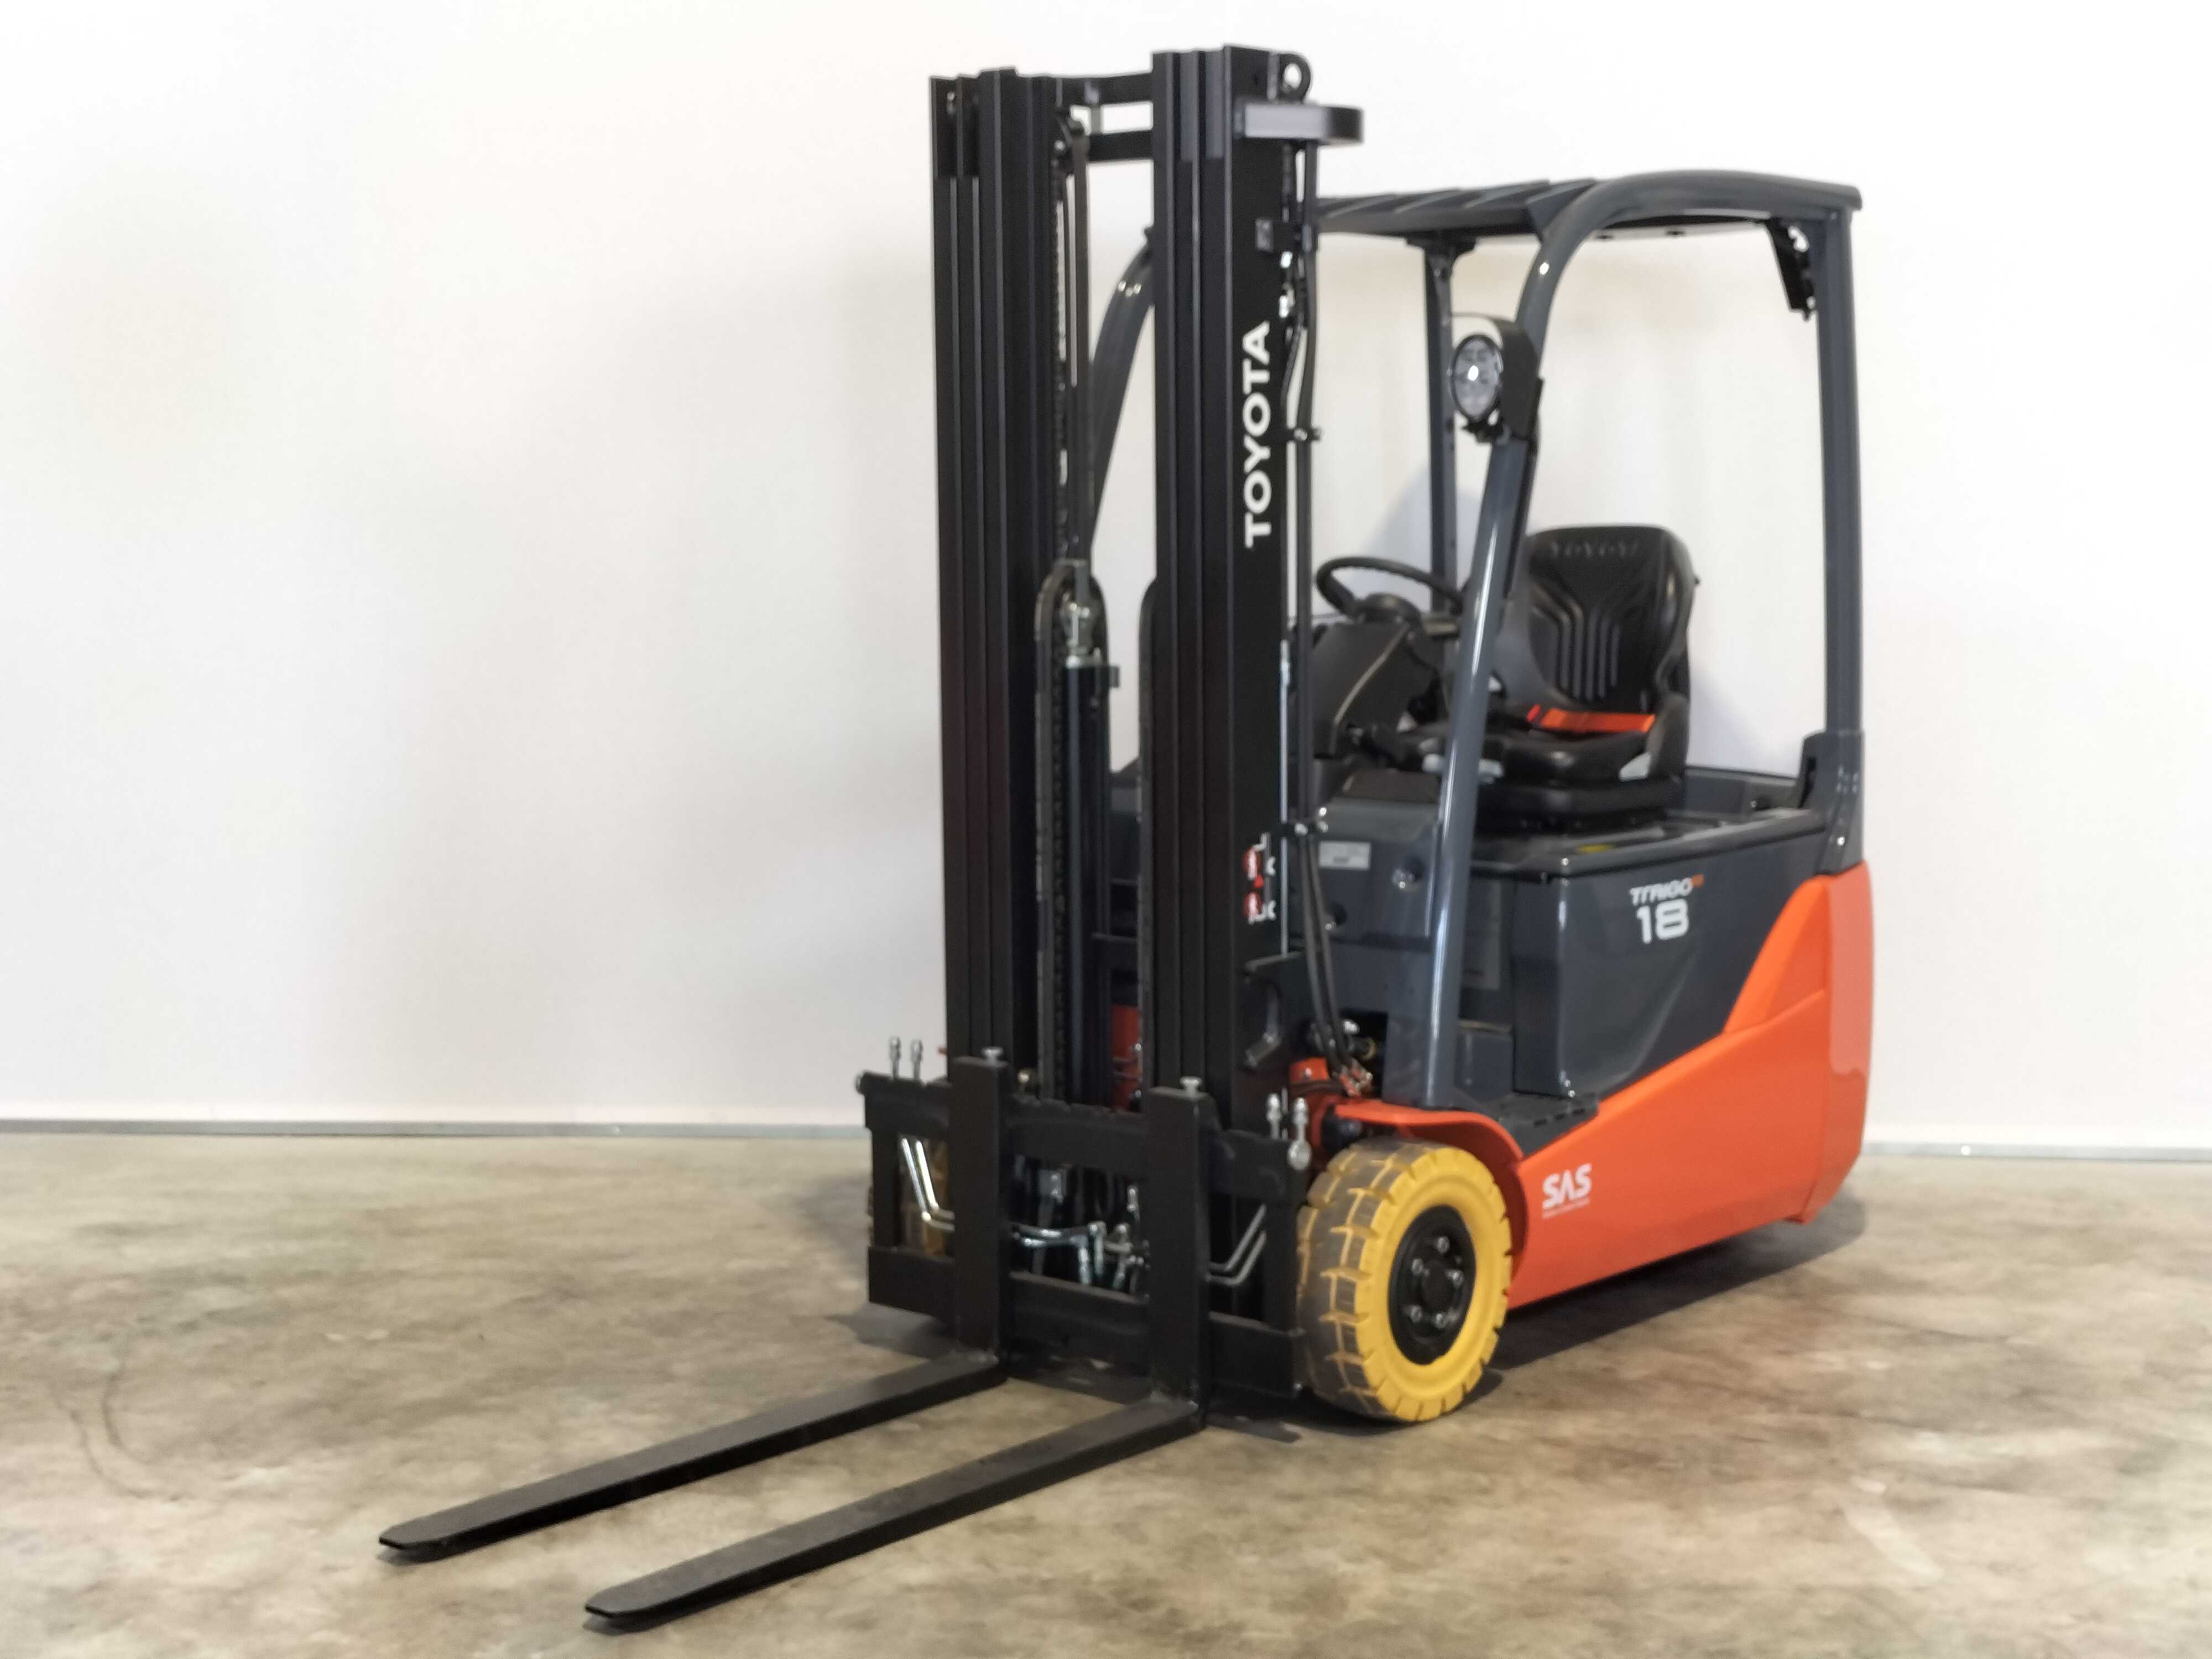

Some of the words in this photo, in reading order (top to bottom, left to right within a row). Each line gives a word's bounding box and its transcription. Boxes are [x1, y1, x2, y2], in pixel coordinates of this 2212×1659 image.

[1242, 321, 1271, 548] TOYOTA
[1636, 898, 1689, 944] 18
[1542, 1163, 1592, 1209] SAS
